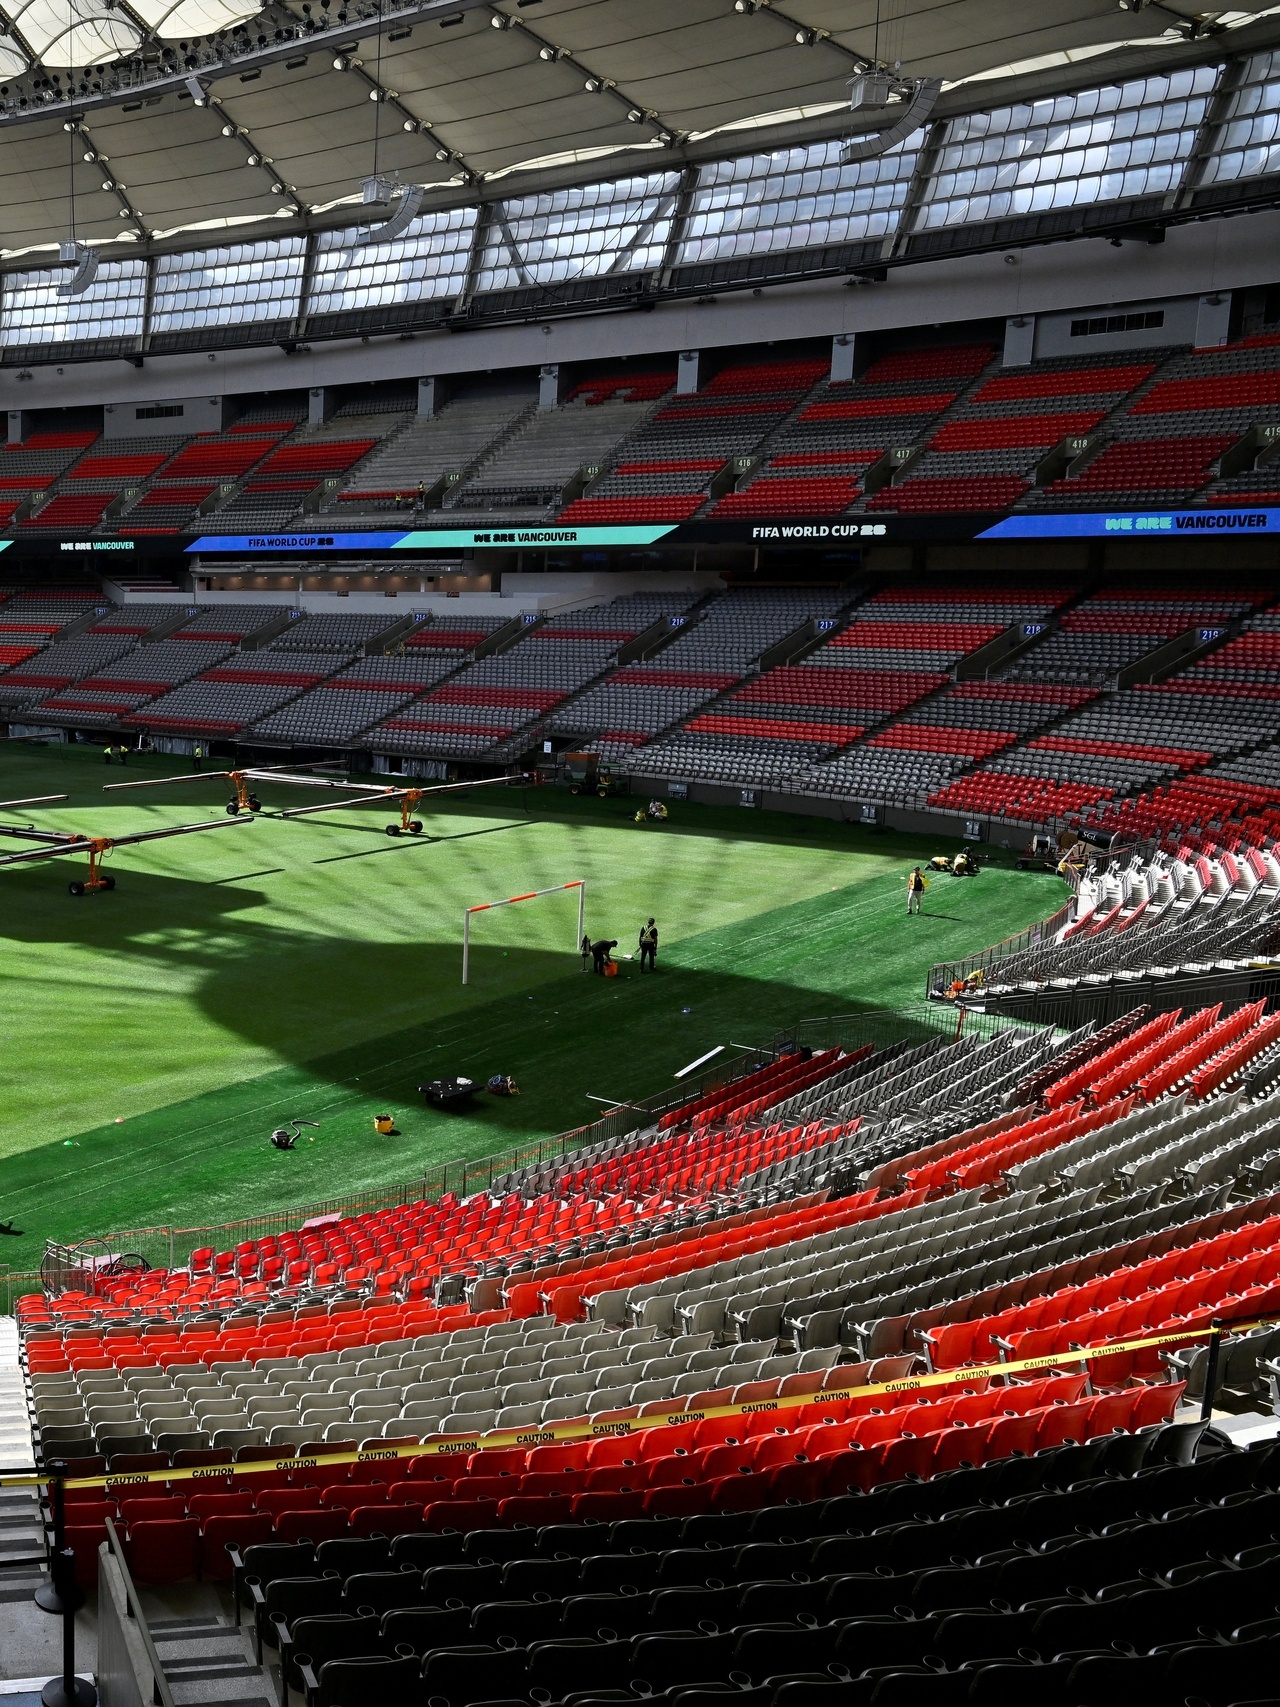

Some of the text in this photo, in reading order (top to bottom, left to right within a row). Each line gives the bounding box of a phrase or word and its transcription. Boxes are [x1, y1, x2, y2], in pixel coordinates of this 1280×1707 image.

[1072, 439, 1088, 448] 418
[896, 450, 910, 458] 417
[738, 459, 750, 467] 416
[588, 466, 598, 474] 415
[1105, 514, 1267, 530] WE ARE VANCOUVER
[753, 527, 780, 538] FIFA
[782, 526, 829, 538] WORLD
[831, 525, 858, 536] CUP
[474, 534, 491, 543] WE
[518, 532, 577, 542] VANCOUVER
[92, 542, 134, 550] VANCOUVER
[248, 539, 266, 547] FIFA
[267, 538, 297, 547] WORLD
[298, 538, 316, 546] CUP
[820, 621, 833, 630] 217
[1083, 831, 1097, 841] SGL
[106, 1475, 149, 1485] CAUTION
[192, 1467, 234, 1478] CAUTION
[276, 1459, 317, 1470] CAUTION
[358, 1450, 398, 1461] CAUTION
[438, 1442, 477, 1452] CAUTION
[516, 1432, 554, 1443] CAUTION
[593, 1422, 630, 1434] CAUTION
[668, 1412, 705, 1425] CAUTION
[741, 1402, 778, 1414] CAUTION
[814, 1392, 850, 1403] CAUTION
[885, 1380, 920, 1392] CAUTION
[955, 1370, 989, 1381] CAUTION
[1024, 1358, 1058, 1369] CAUTION
[1092, 1346, 1125, 1358] CAUTION
